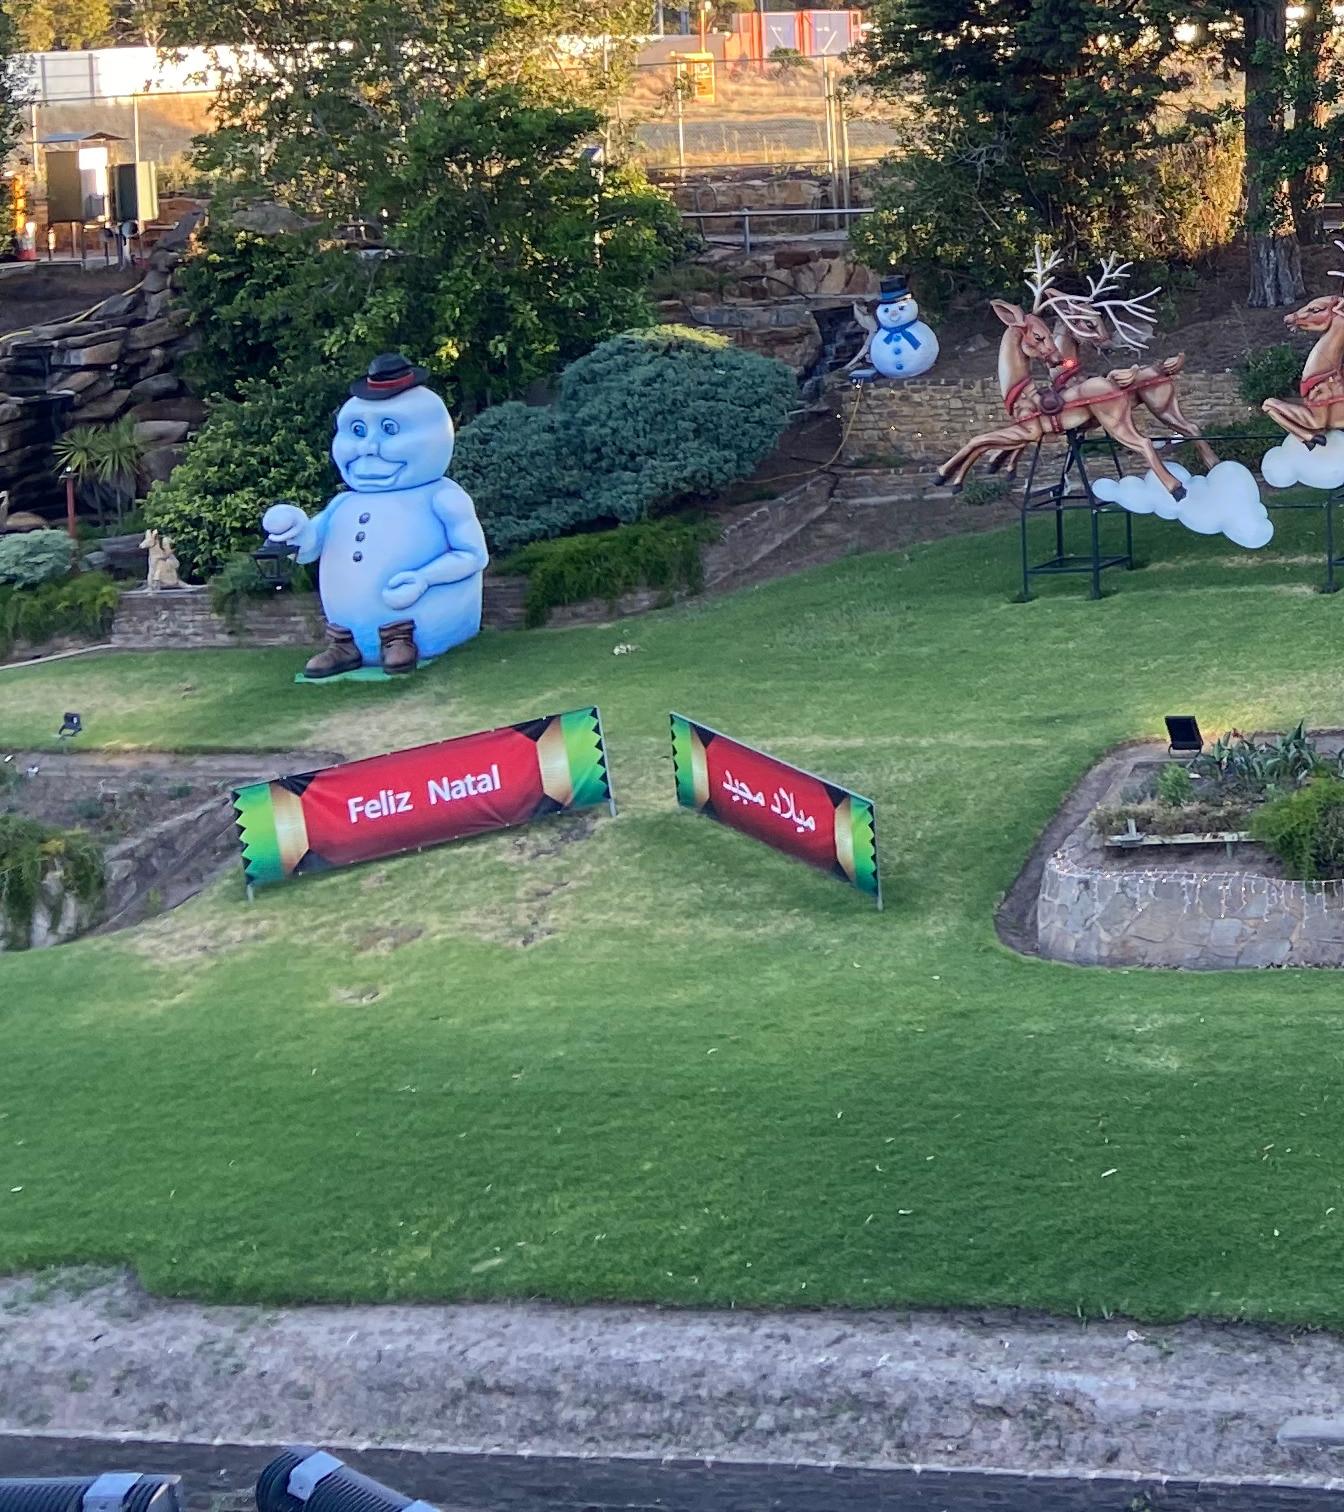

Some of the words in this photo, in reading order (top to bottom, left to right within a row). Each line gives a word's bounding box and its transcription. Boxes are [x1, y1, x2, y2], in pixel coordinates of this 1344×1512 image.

[347, 789, 413, 823] Feliz
[427, 763, 502, 805] Natal
[722, 769, 765, 806] مجيد
[770, 787, 816, 833] ميلاد
